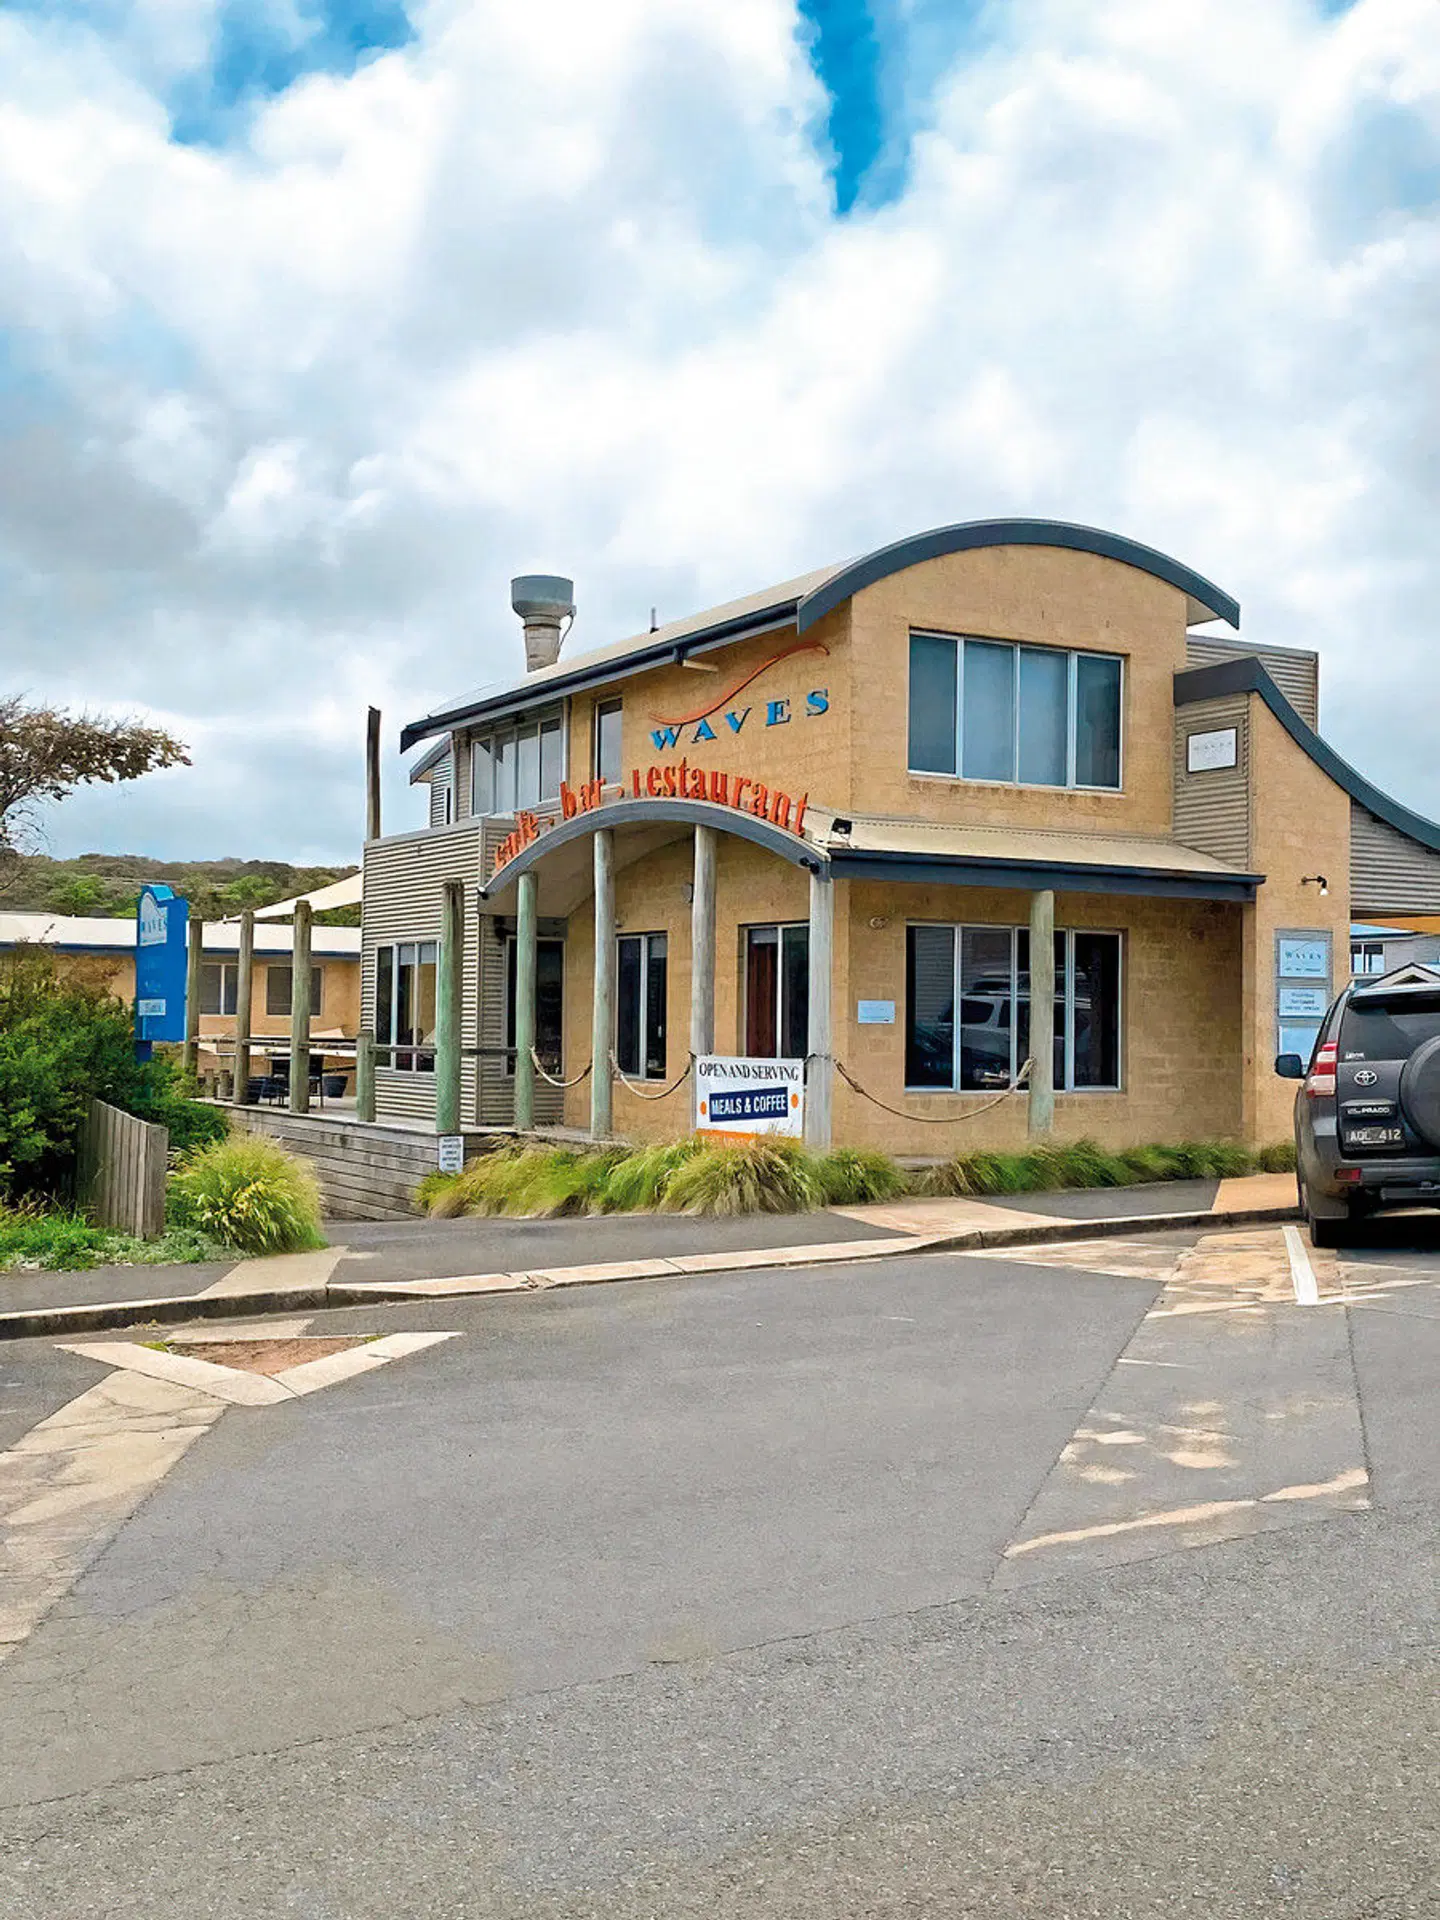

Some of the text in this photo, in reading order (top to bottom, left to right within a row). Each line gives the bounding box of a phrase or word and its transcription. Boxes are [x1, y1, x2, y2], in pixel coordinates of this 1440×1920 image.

[650, 689, 830, 751] WAVES
[560, 777, 606, 820] bar
[632, 756, 808, 838] restaurant
[699, 1062, 799, 1081] OPEN AND SERVING
[711, 1094, 786, 1116] MEALS & COFFEE
[1379, 1128, 1401, 1141] 412
